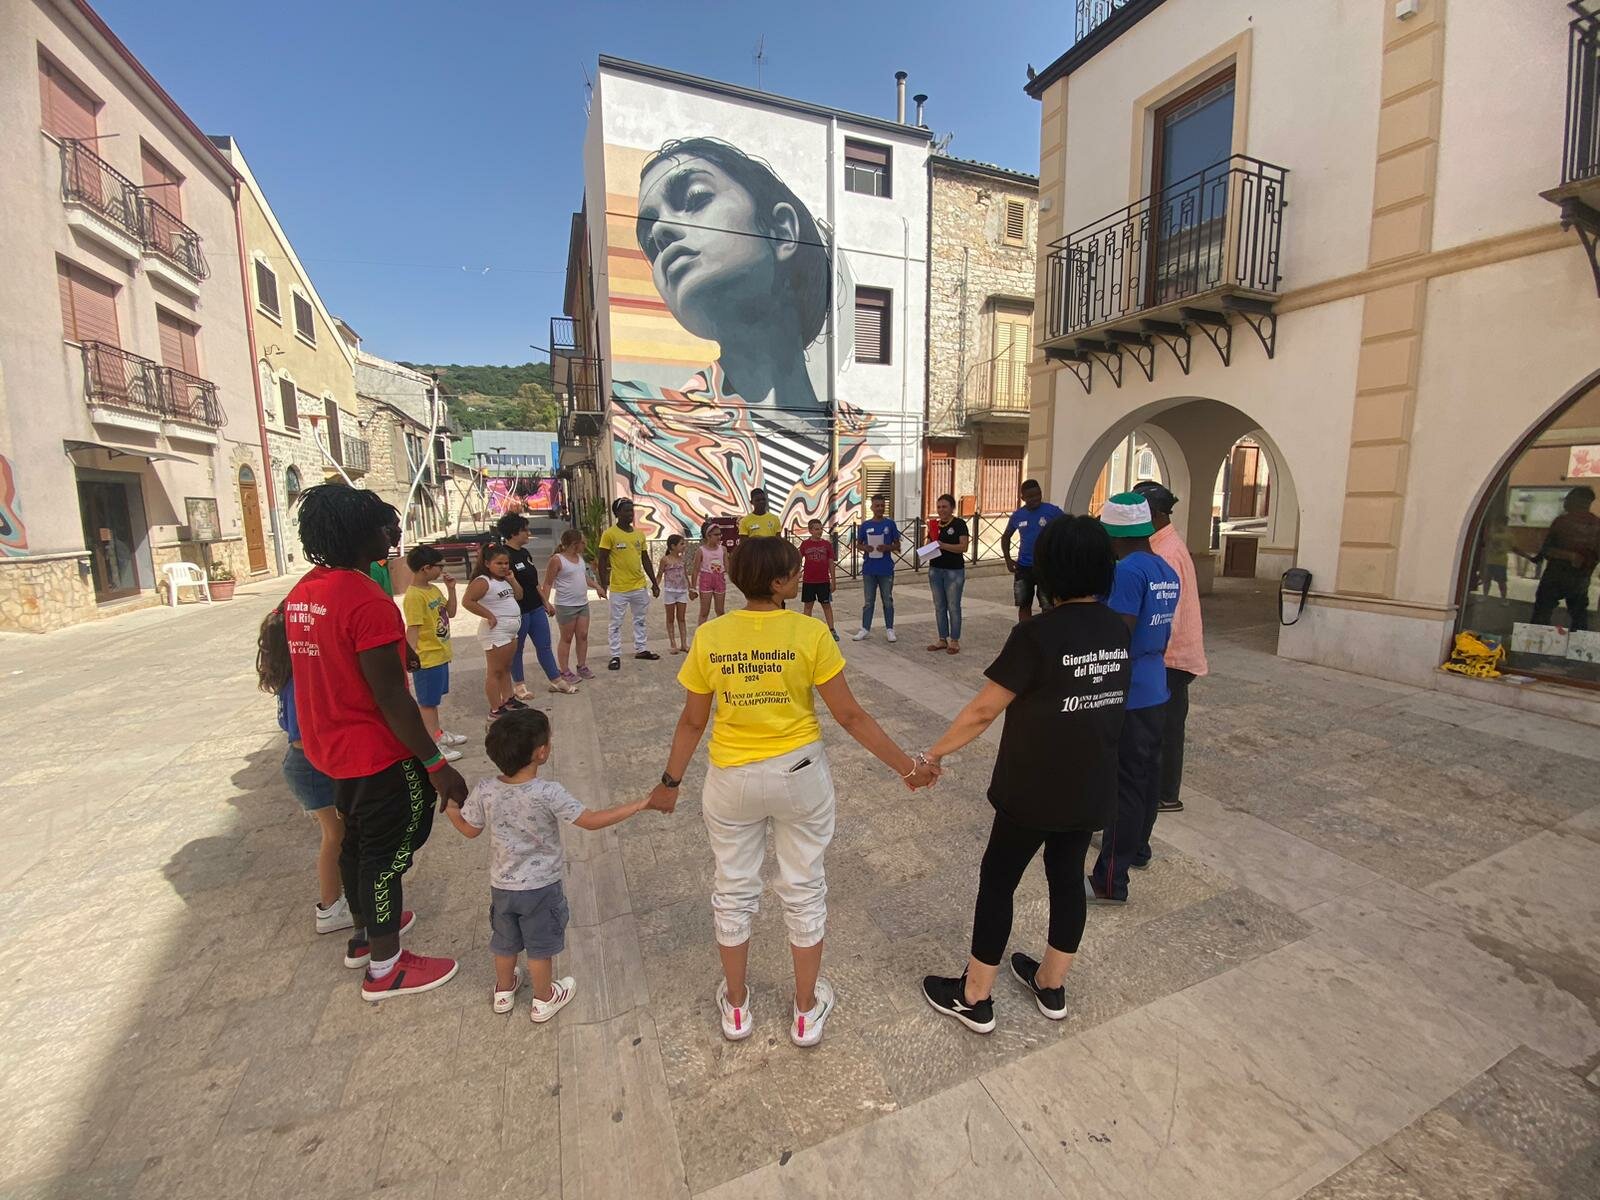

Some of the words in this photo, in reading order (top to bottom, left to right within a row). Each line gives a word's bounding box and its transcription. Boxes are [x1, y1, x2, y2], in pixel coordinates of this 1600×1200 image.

[1149, 613, 1161, 626] 10
[709, 651, 748, 664] Giornata
[751, 649, 796, 661] Mondiale
[1062, 651, 1097, 666] Giornata
[721, 663, 735, 675] del
[737, 662, 782, 674] Rifugiato
[1074, 665, 1087, 678] del
[1088, 661, 1121, 675] Rifugiato
[744, 674, 760, 683] 2024
[1060, 696, 1079, 713] 10
